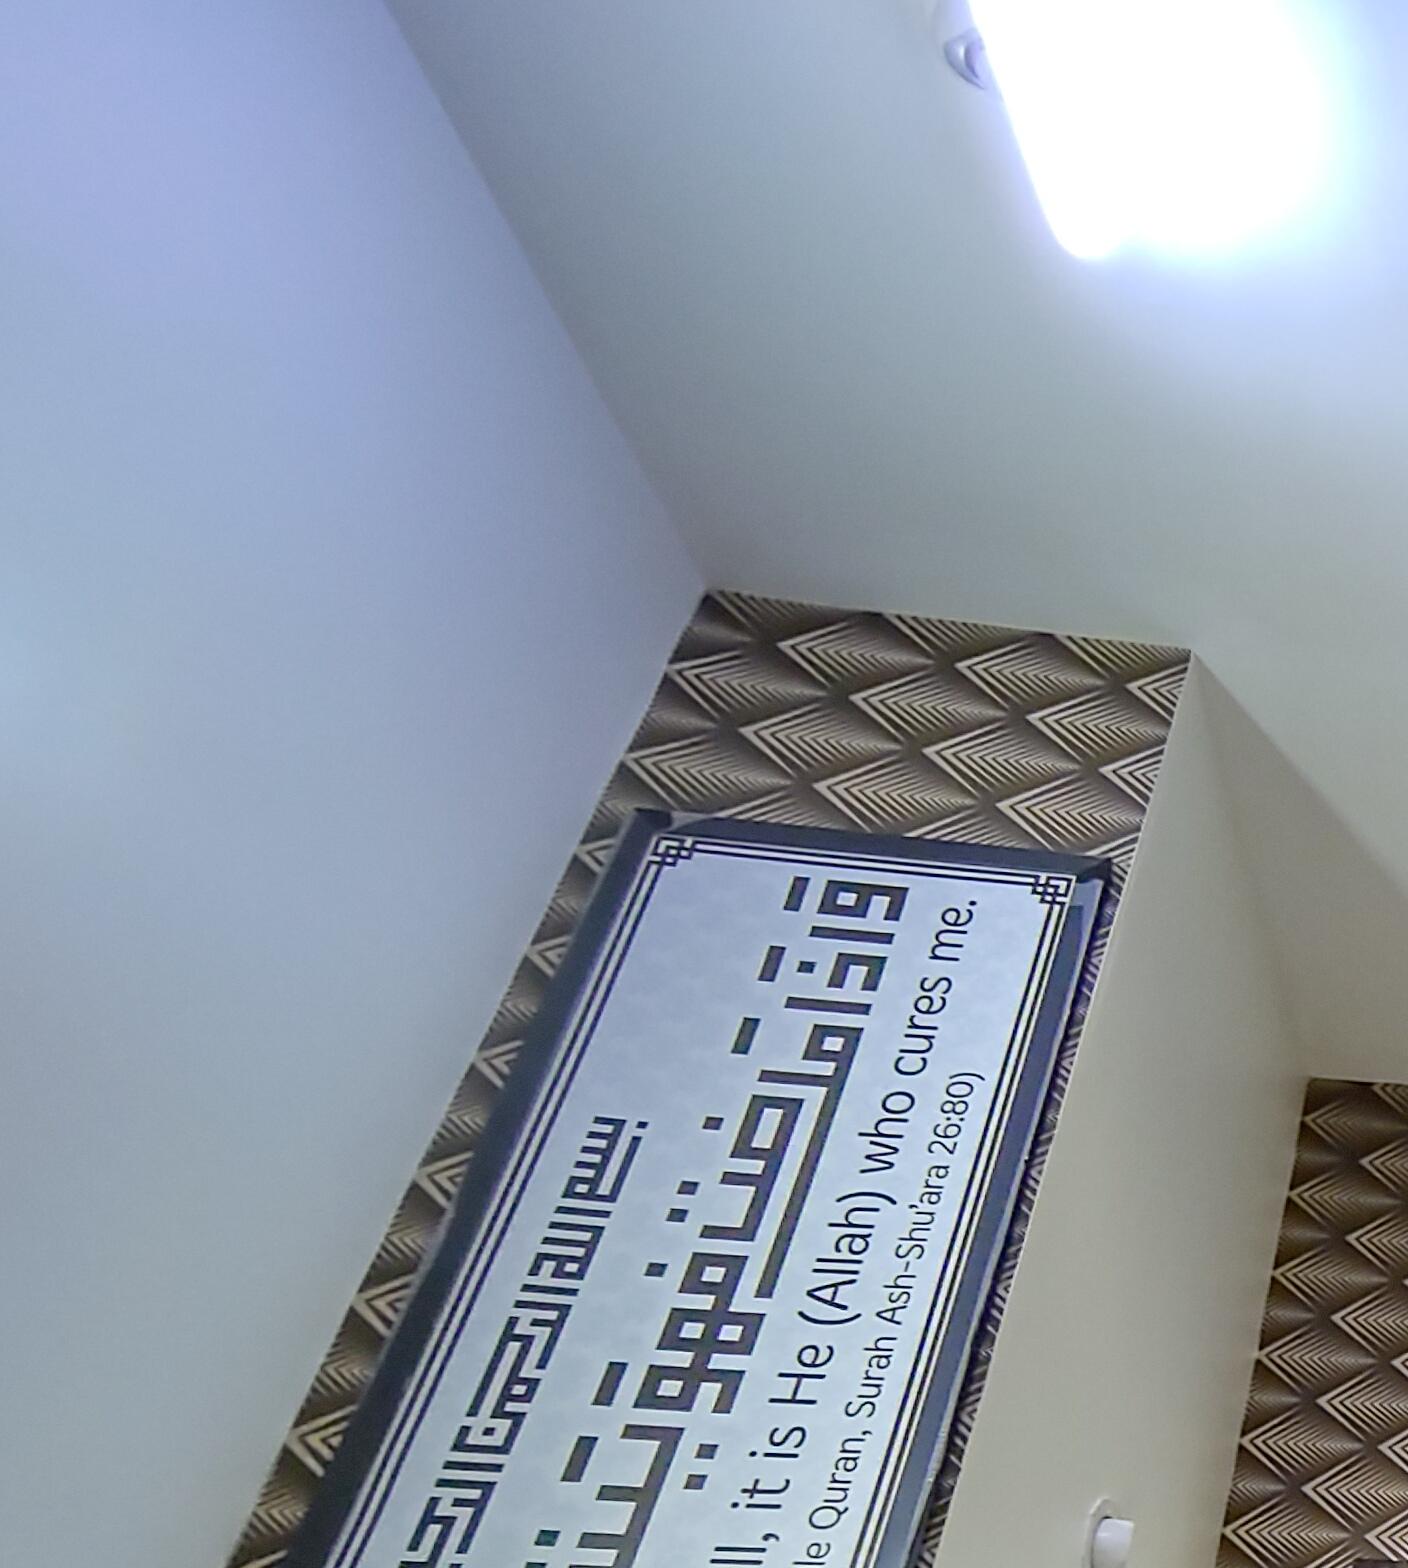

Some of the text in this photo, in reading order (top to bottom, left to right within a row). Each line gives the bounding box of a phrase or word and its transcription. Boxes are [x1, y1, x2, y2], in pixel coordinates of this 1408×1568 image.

[928, 900, 978, 961] me.
[894, 977, 952, 1076] cures
[858, 1091, 915, 1174] who
[797, 1192, 897, 1325] (Allah)
[808, 1429, 873, 1531] Quran,
[844, 1337, 898, 1418] Surah
[928, 1072, 985, 1156] 26:80)
[768, 1345, 834, 1405] He
[748, 1426, 806, 1458] is
[731, 1478, 790, 1509] it
